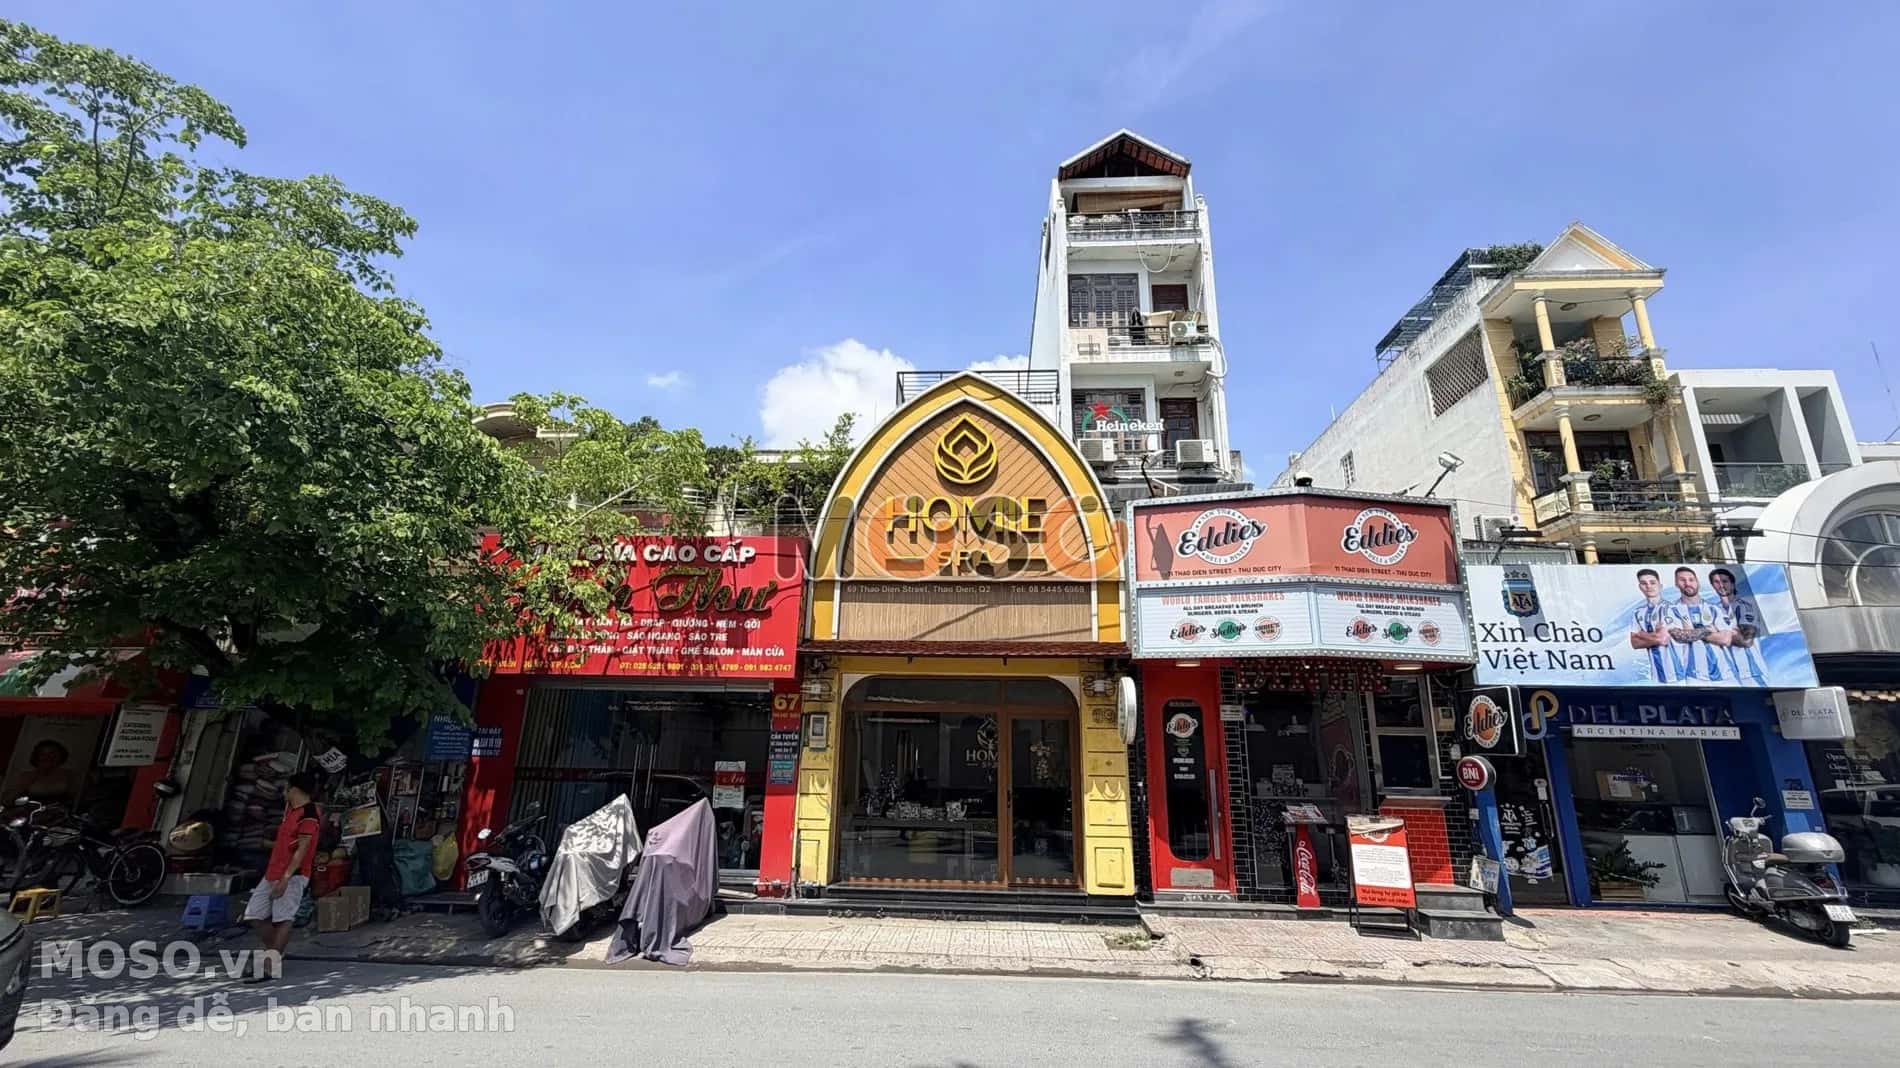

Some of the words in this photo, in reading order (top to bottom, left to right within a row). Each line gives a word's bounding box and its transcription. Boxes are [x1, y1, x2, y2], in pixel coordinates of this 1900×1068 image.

[1096, 418, 1164, 432] Heineken
[887, 496, 1047, 532] HOME
[1178, 520, 1266, 556] Eddie's
[1343, 522, 1418, 552] Eddie's
[643, 544, 697, 562] CAO
[703, 539, 756, 563] CẤP
[935, 551, 997, 568] SPA
[1161, 594, 1191, 605] WORLD
[1194, 593, 1228, 603] FAMOUS
[1230, 591, 1285, 602] MILKSHAKES
[1479, 621, 1529, 643] Xin
[1533, 620, 1604, 644] Chào
[703, 647, 734, 657] SALON
[1482, 647, 1541, 675] Việt
[1544, 649, 1617, 672] Nam
[774, 693, 800, 711] 67
[1568, 704, 1628, 724] DEL
[1638, 704, 1737, 725] PLATA
[1576, 727, 1667, 737] ARGENTINA
[1676, 727, 1738, 738] MARKET
